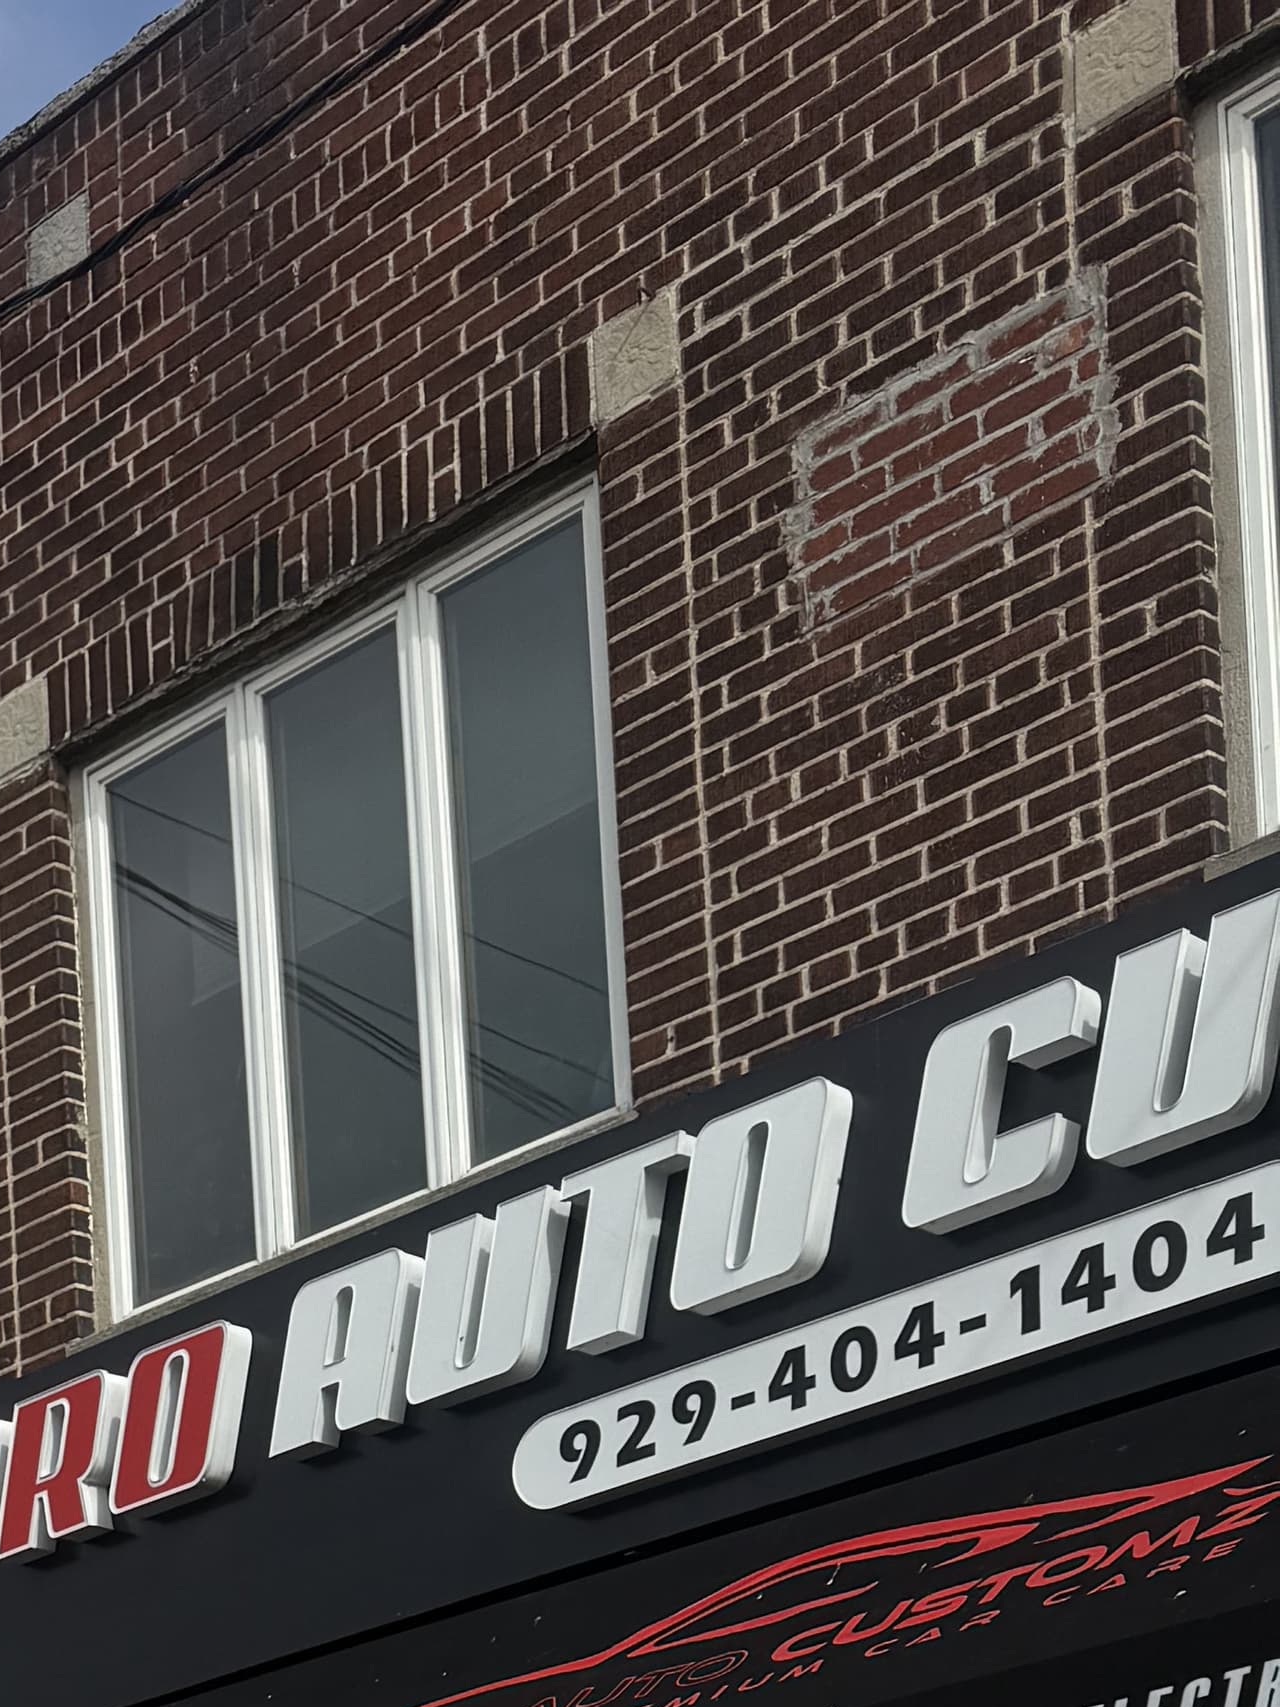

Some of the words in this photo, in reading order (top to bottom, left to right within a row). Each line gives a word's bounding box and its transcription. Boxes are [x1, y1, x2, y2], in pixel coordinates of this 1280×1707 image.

[270, 1076, 852, 1461] AUTO
[557, 1191, 1266, 1484] 929-404-1404
[771, 1490, 1280, 1661] CUSTOMZ
[865, 1611, 1000, 1656] CAR
[1043, 1538, 1244, 1607] CARE
